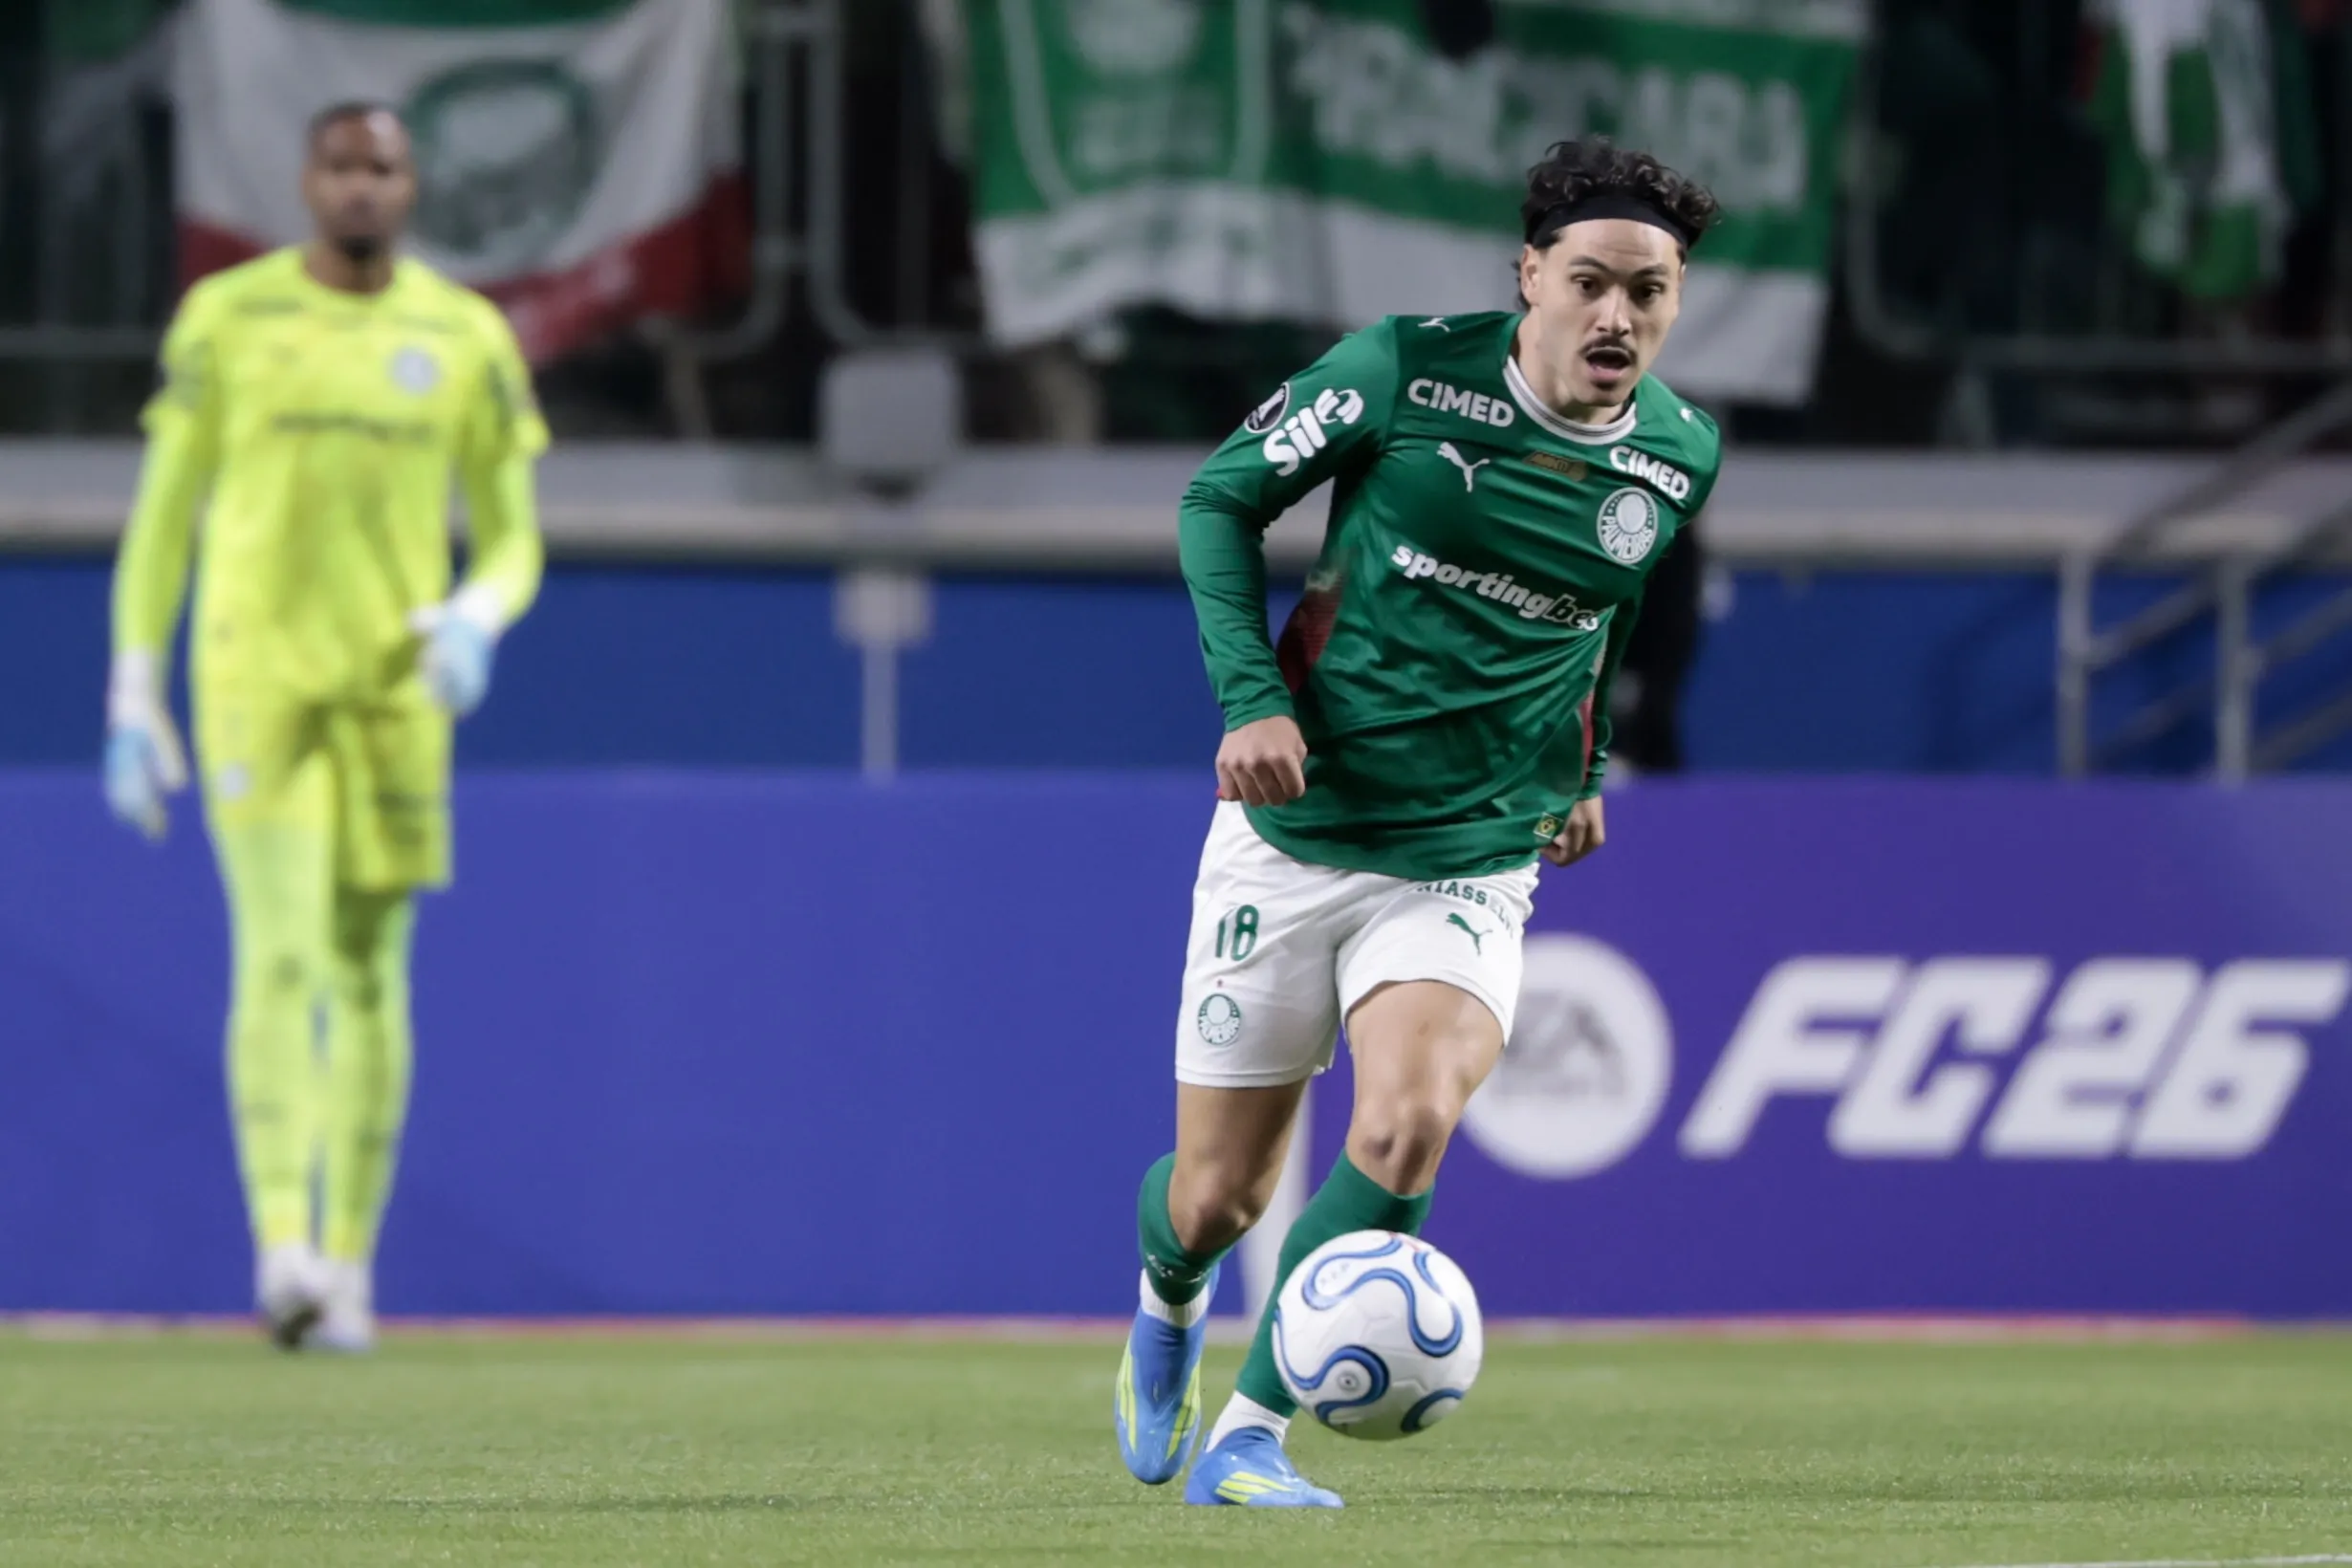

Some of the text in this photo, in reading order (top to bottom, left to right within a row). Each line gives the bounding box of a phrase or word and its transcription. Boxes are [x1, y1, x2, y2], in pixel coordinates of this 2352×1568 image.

[1407, 379, 1514, 427] CIMED
[1609, 446, 1689, 499] CIMED
[1391, 545, 1599, 632] sportingbe
[1215, 904, 1259, 962] 18
